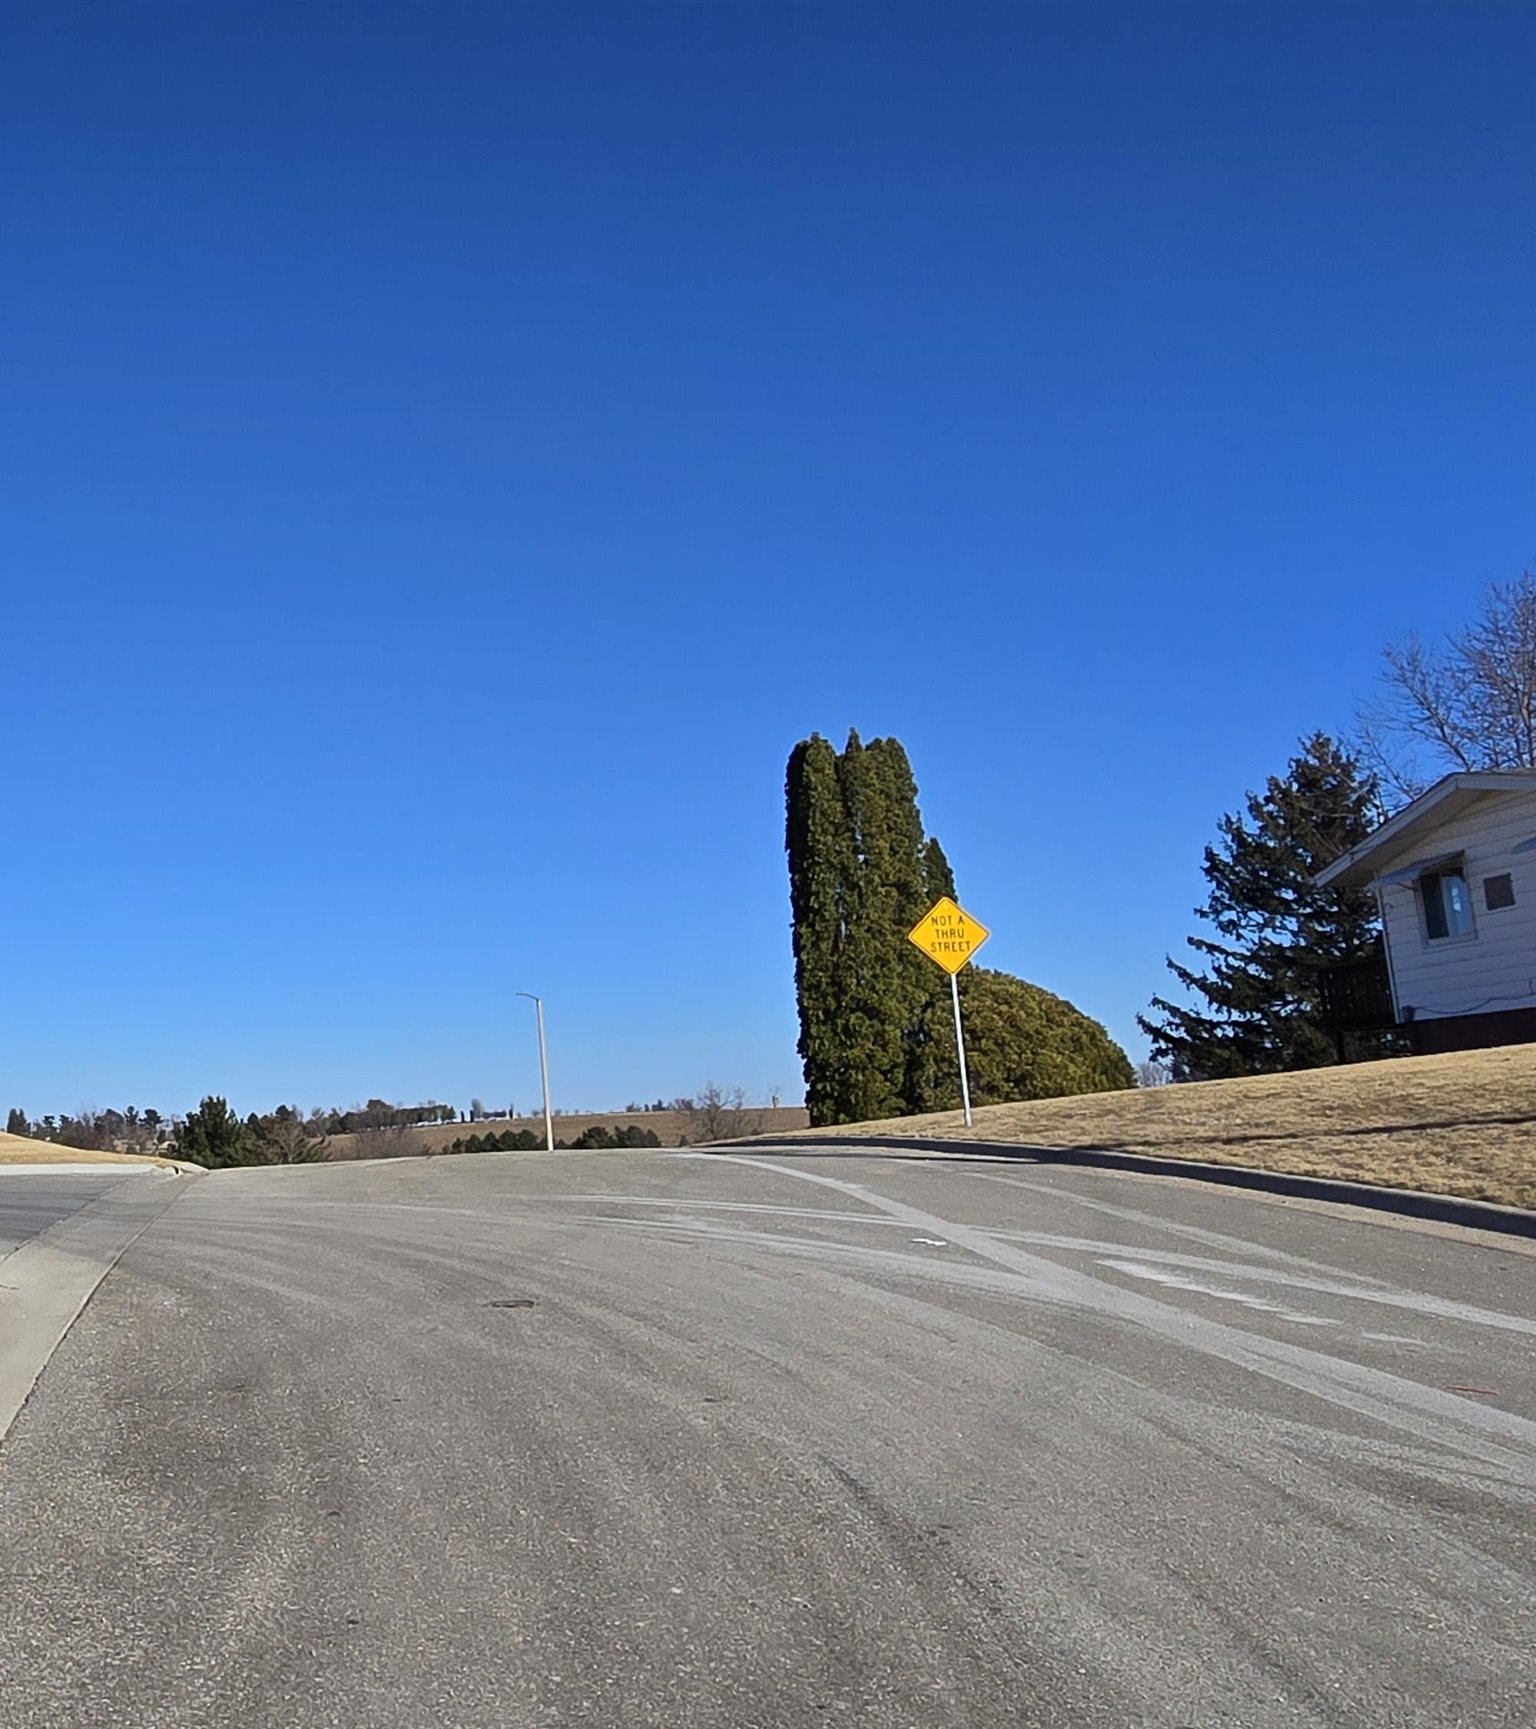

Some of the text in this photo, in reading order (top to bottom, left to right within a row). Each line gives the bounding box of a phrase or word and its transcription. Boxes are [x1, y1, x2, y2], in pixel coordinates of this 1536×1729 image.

[931, 915, 965, 926] NOT A
[935, 928, 964, 939] THRU
[930, 941, 970, 953] STREET
